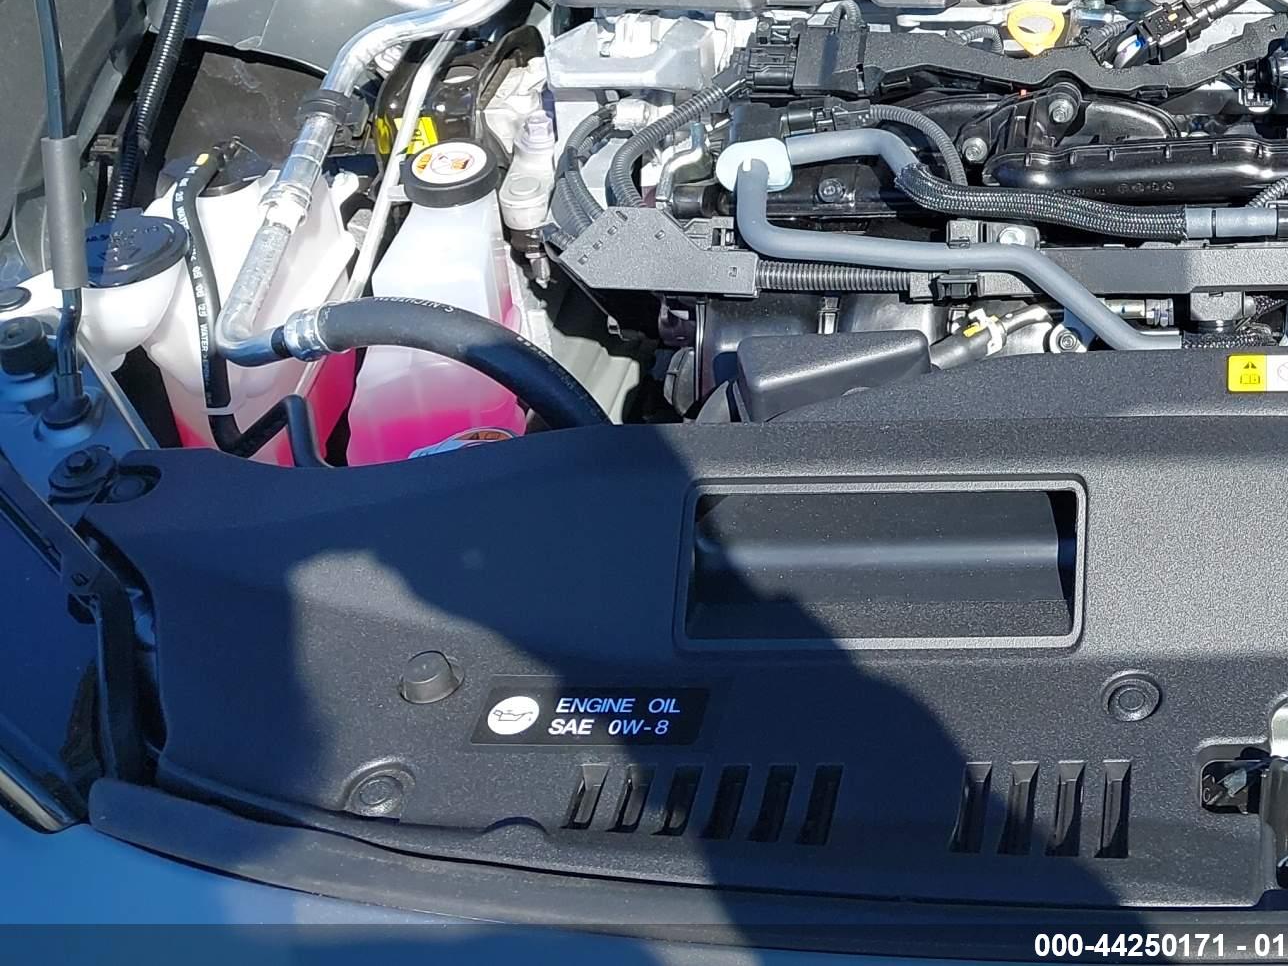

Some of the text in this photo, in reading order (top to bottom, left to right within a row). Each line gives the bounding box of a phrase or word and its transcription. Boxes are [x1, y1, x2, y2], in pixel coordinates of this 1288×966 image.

[200, 324, 209, 352] WATER
[555, 697, 681, 713] ENGINE OIL
[548, 718, 669, 735] SAE 0W-8
